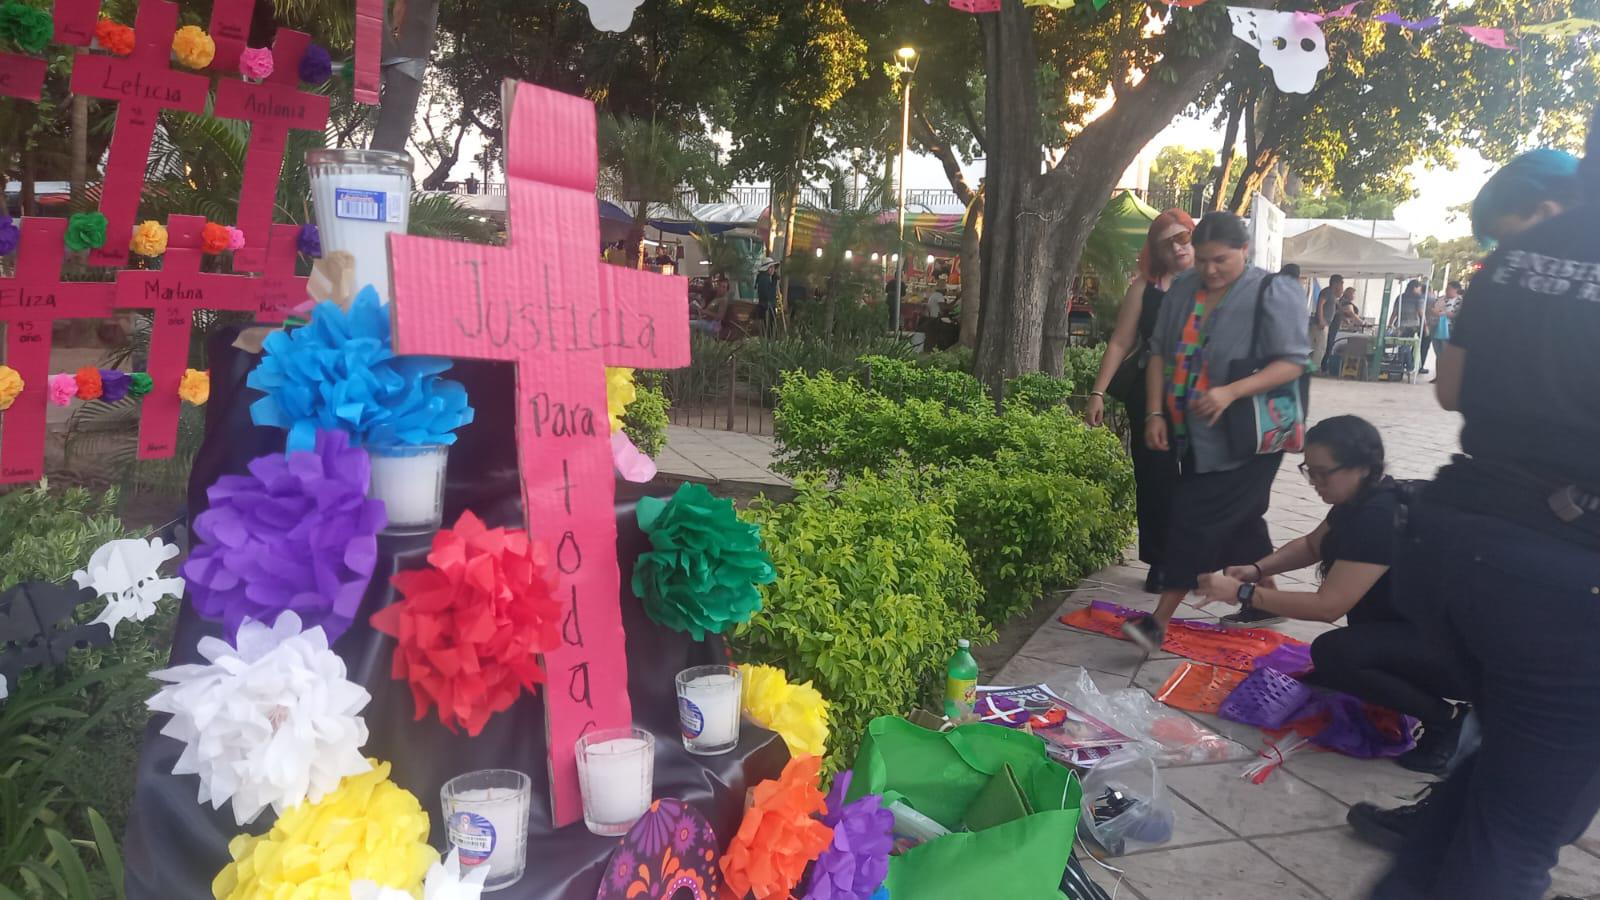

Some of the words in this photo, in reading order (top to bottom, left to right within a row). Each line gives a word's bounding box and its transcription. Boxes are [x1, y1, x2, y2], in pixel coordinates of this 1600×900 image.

[102, 64, 182, 102] Leticia
[0, 287, 56, 308] Eliza
[455, 259, 658, 359] Justicia
[528, 391, 597, 438] Para
